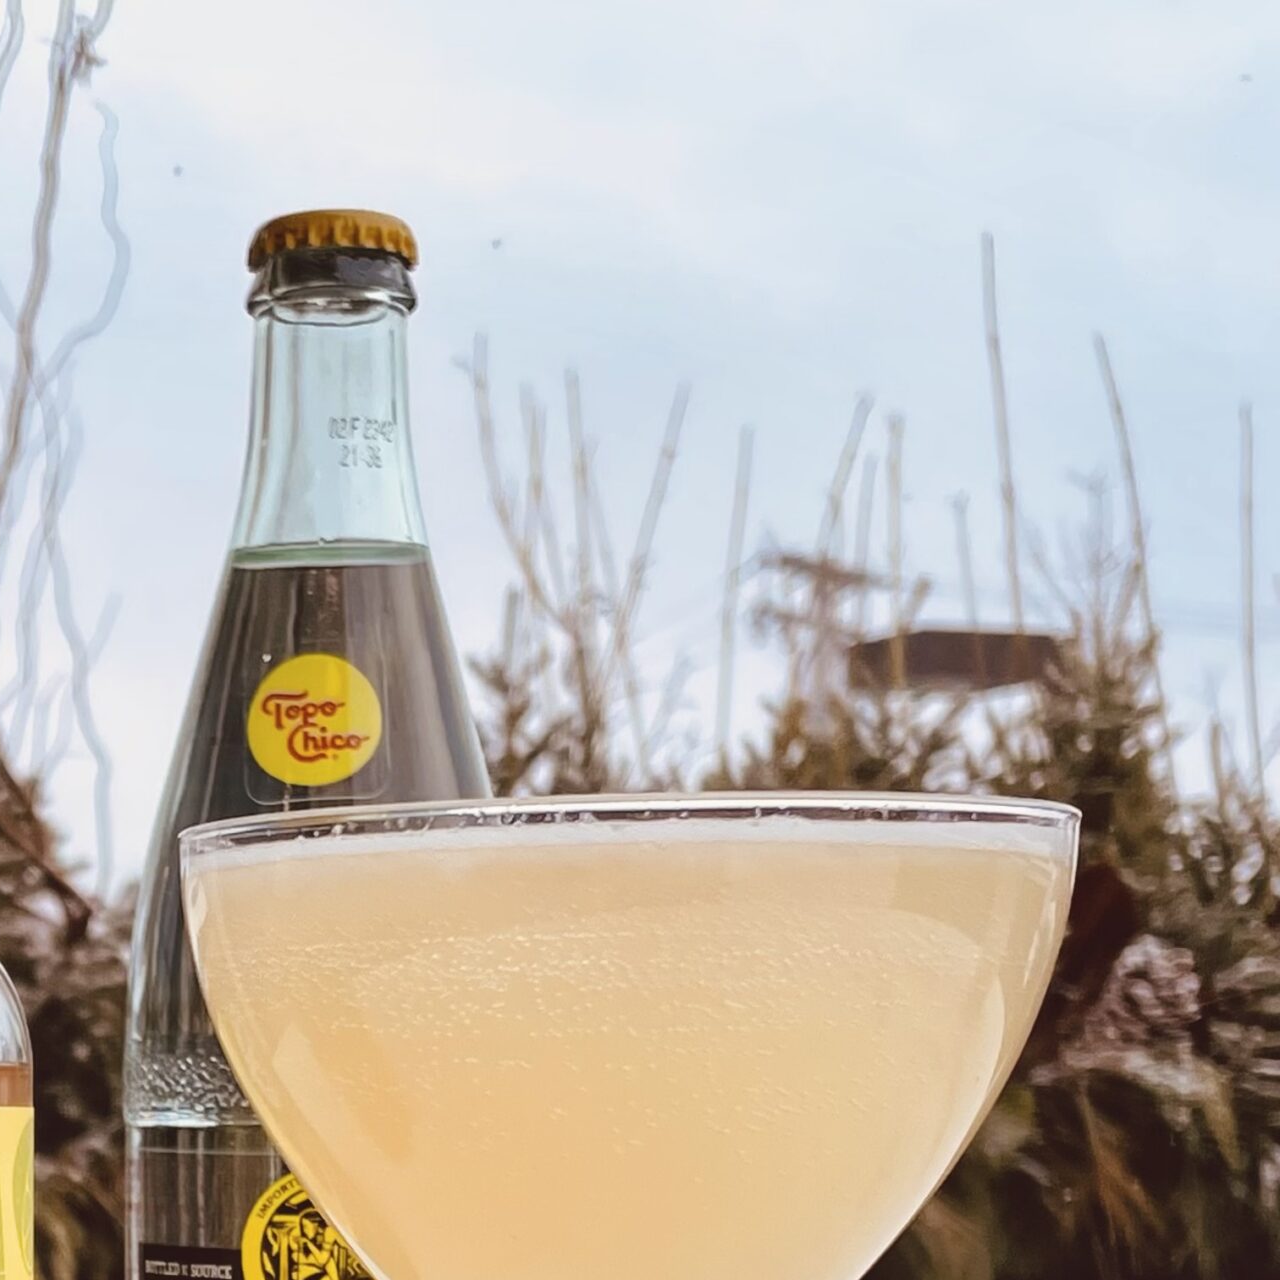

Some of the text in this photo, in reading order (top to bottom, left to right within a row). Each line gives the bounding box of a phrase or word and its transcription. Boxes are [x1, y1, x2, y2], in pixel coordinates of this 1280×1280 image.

[261, 689, 346, 731] Topo
[287, 722, 370, 764] Chico
[190, 1263, 233, 1280] SOURCE
